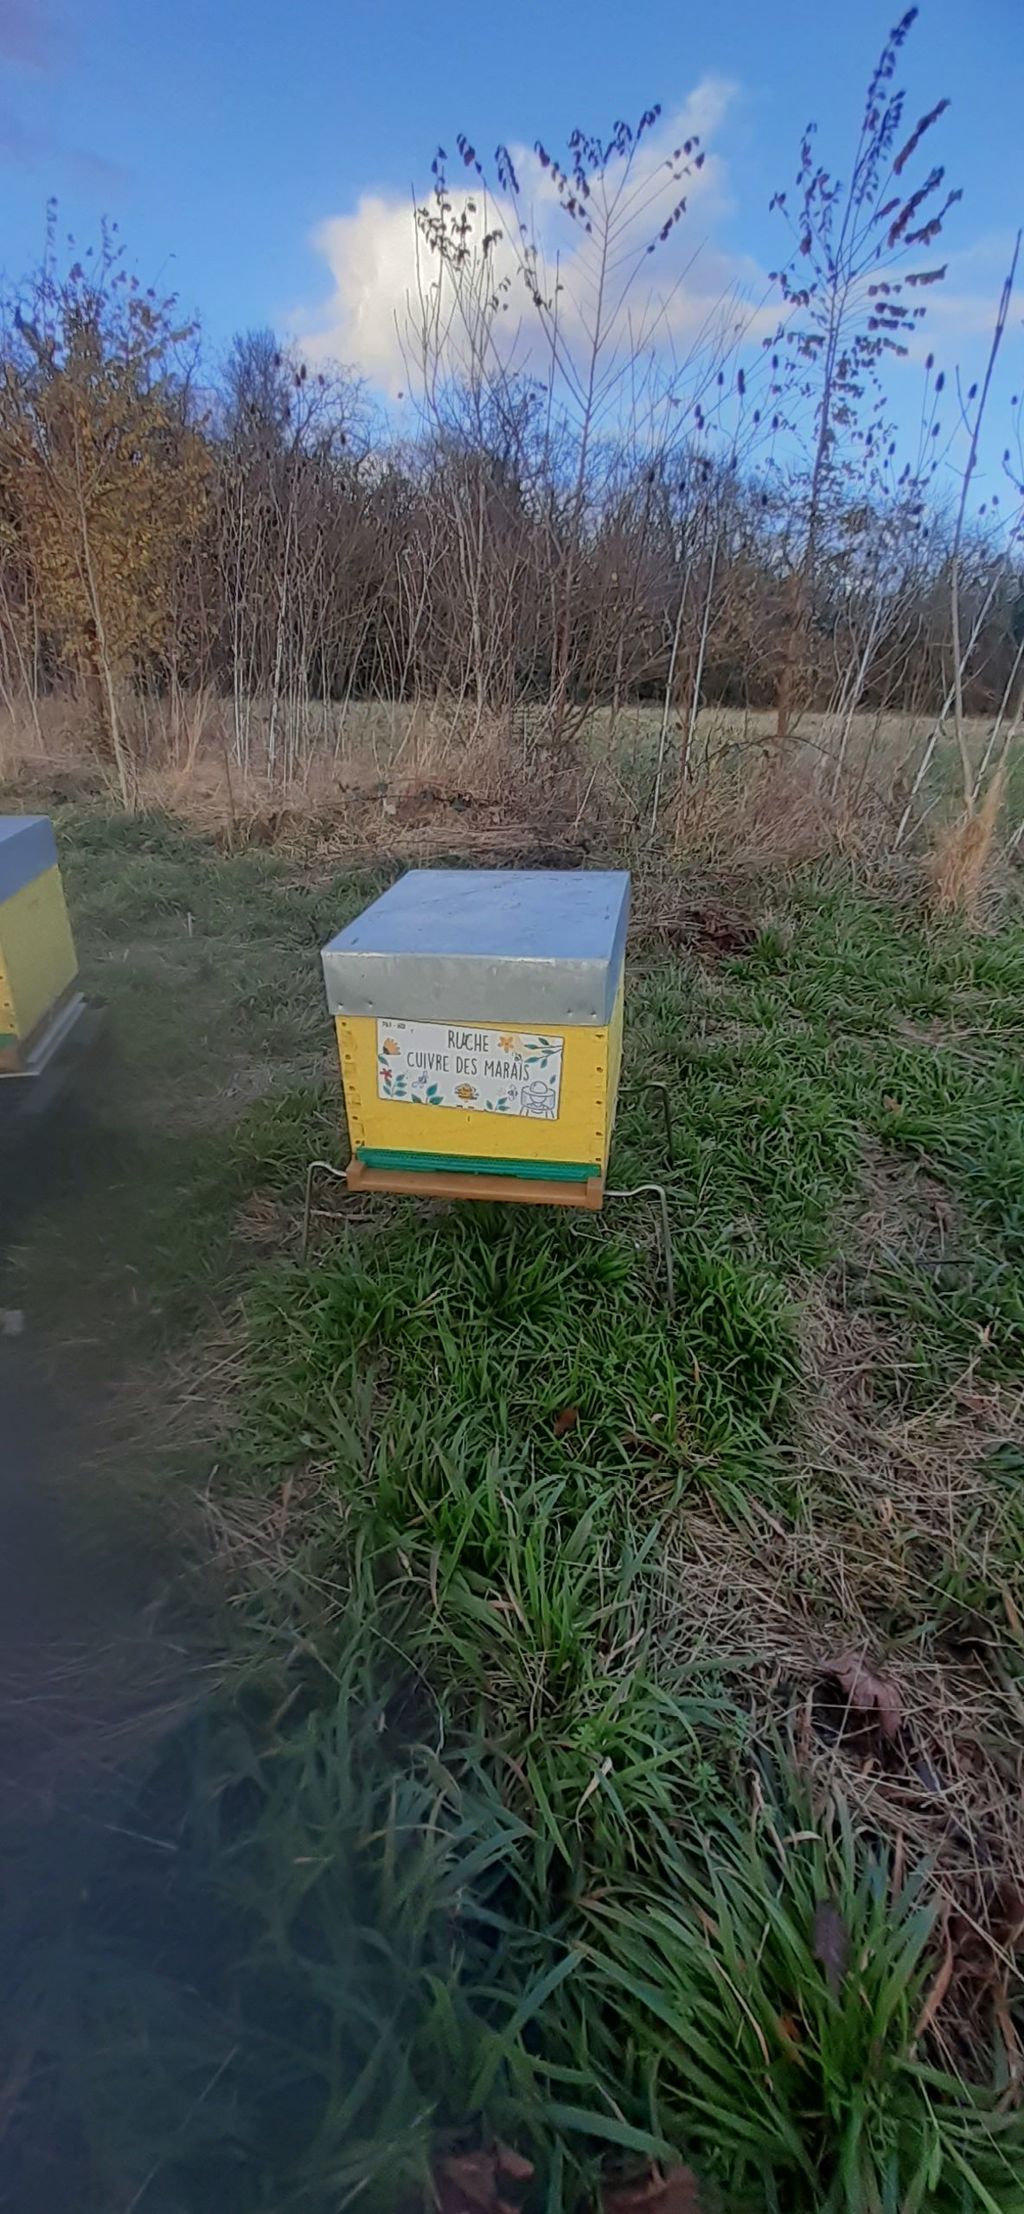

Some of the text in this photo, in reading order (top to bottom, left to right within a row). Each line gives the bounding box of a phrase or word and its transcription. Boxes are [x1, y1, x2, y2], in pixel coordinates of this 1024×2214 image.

[448, 1029, 489, 1052] RUCHE
[407, 1051, 530, 1082] CUIVRE DES MARAIS
